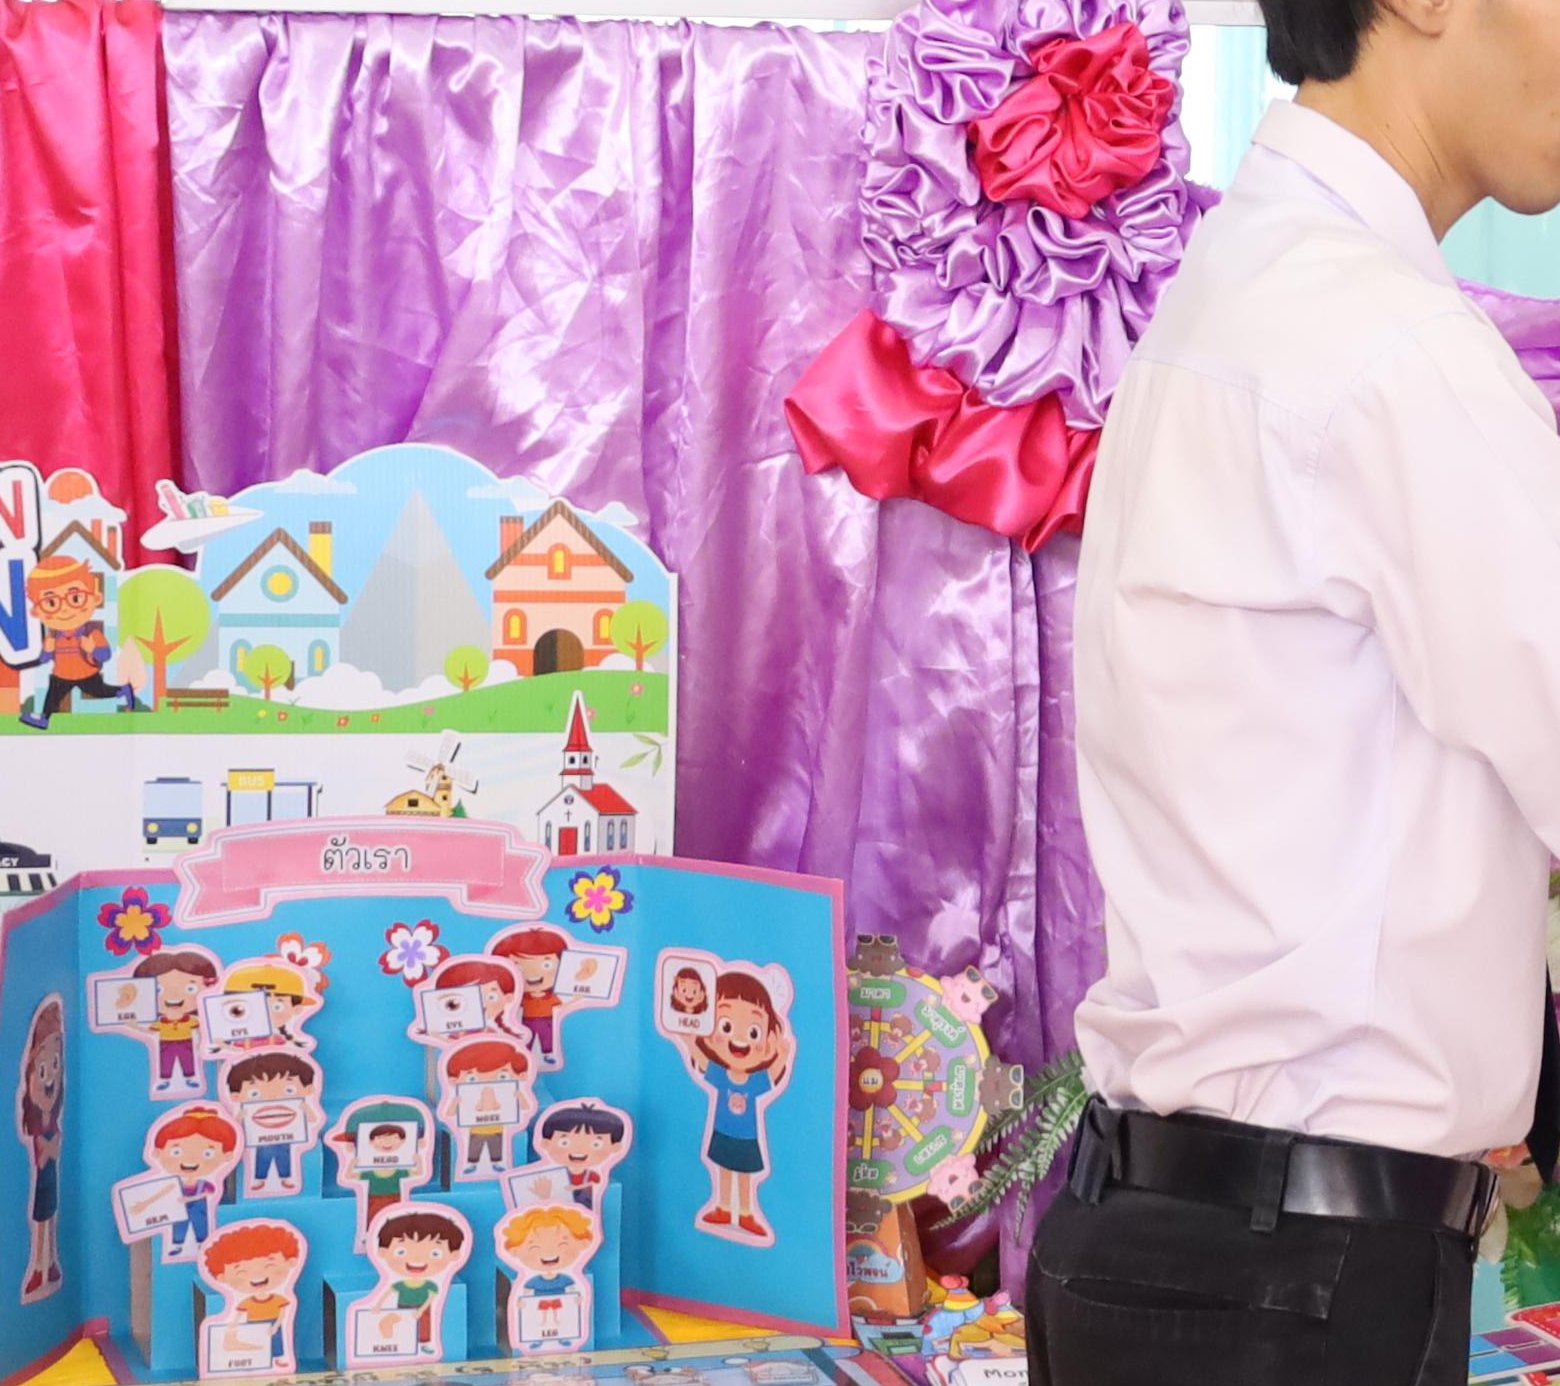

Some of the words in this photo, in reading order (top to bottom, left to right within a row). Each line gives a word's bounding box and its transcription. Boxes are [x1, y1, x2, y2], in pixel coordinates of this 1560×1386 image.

[238, 773, 265, 787] BUS
[320, 835, 411, 873] ตัวเรา
[678, 1016, 701, 1030] HEAD
